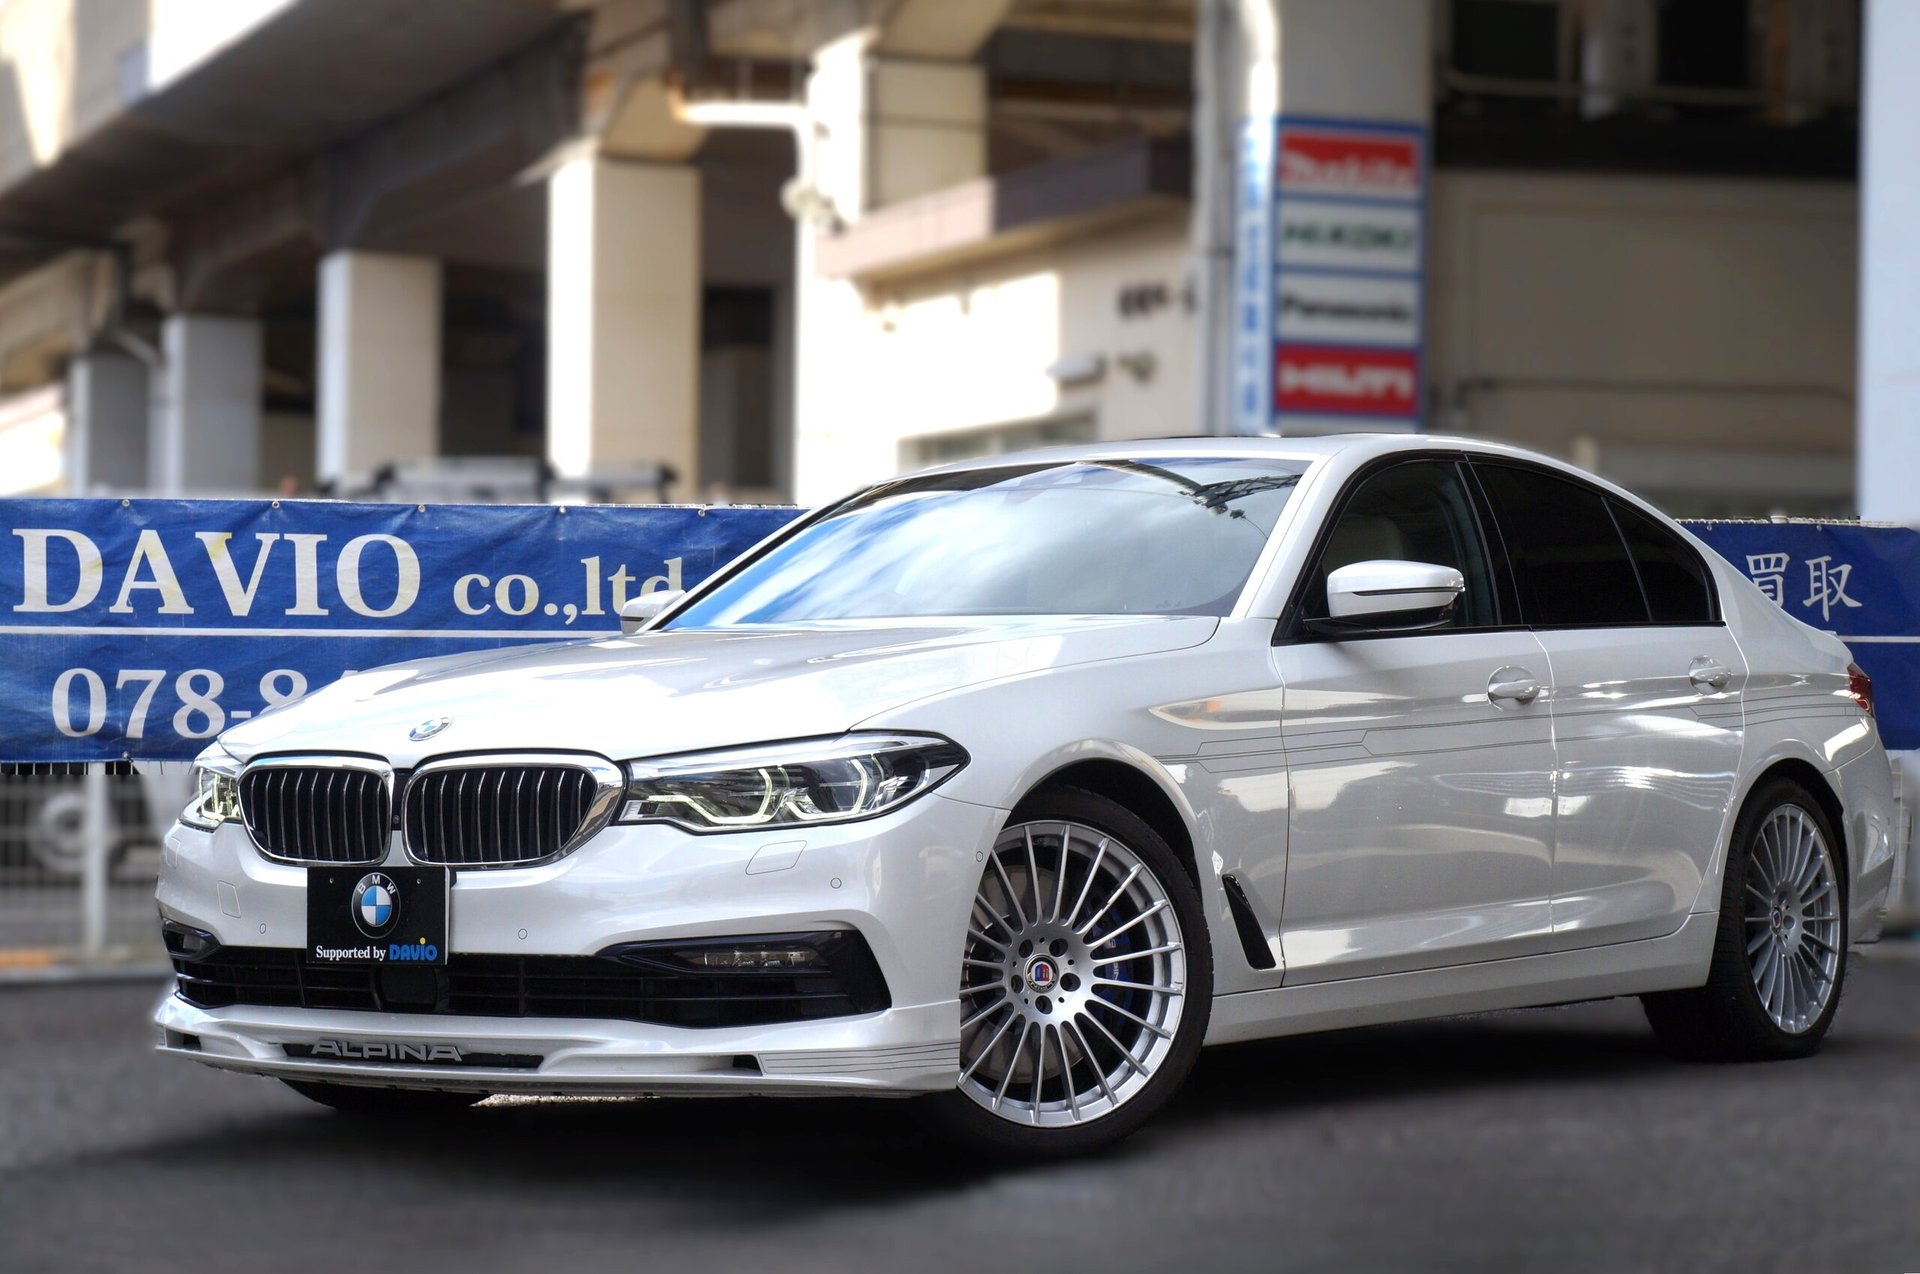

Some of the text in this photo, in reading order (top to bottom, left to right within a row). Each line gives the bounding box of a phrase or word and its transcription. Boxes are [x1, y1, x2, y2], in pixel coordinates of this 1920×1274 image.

[12, 528, 421, 617] DAVIO
[358, 874, 396, 895] BMW
[316, 945, 371, 961] Supported
[373, 945, 386, 961] by
[311, 1039, 463, 1062] ALPINA
